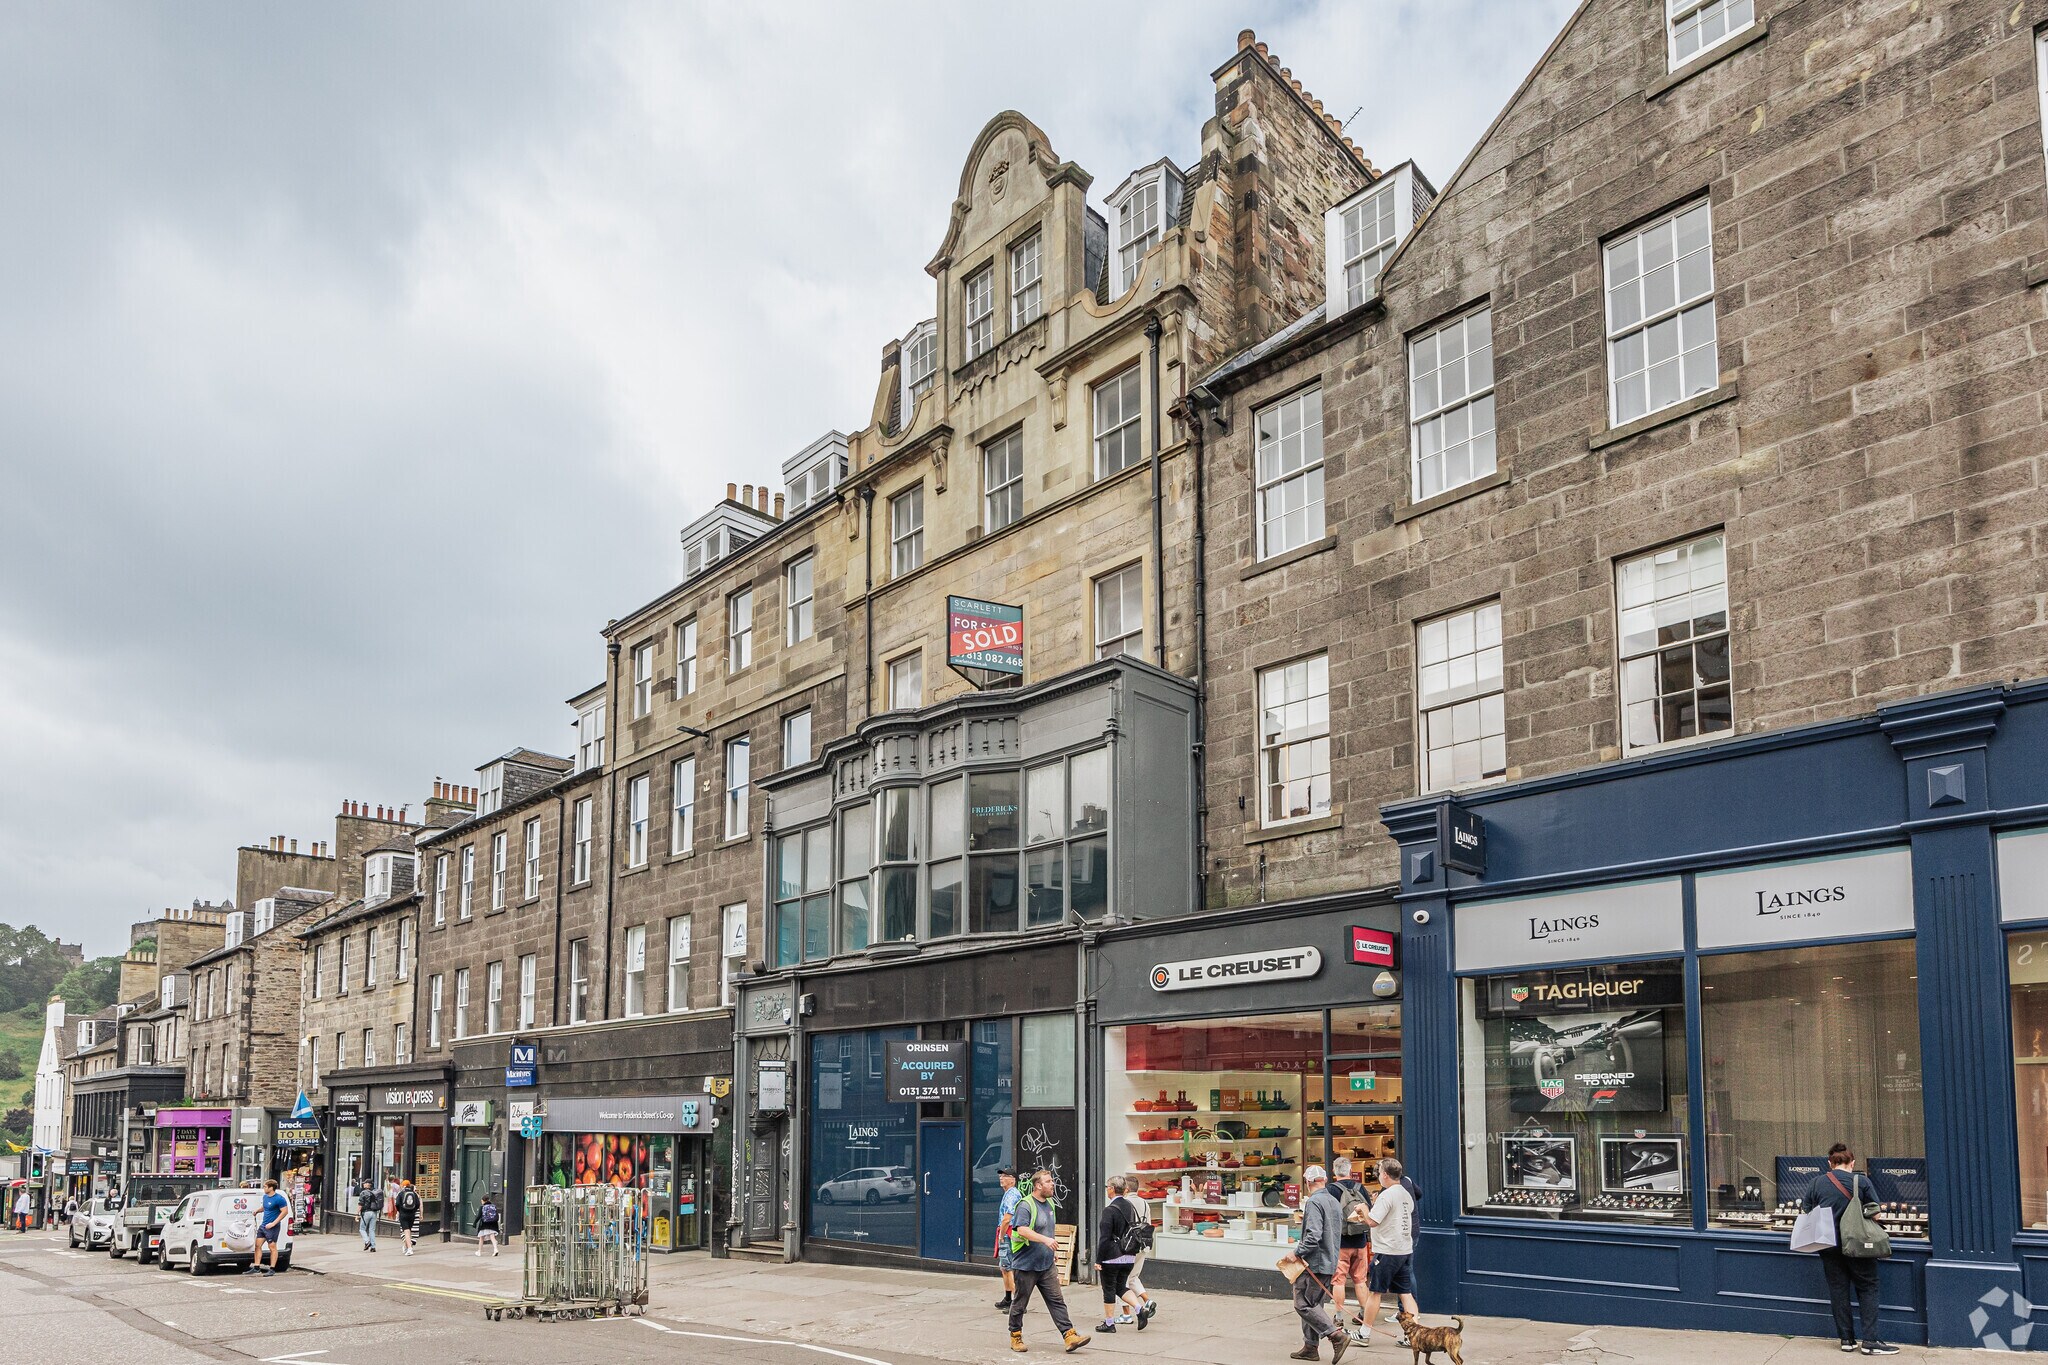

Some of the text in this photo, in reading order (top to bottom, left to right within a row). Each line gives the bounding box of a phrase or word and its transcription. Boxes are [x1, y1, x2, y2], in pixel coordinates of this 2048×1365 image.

[954, 599, 1002, 614] SCARLETT
[954, 617, 978, 630] FOR
[962, 626, 1017, 650] SOLD
[985, 653, 1004, 664] 082
[1006, 656, 1023, 667] 468
[971, 804, 1018, 814] FREDERICKS
[1454, 826, 1478, 846] LAINGS
[1755, 886, 1845, 916] LAINGS
[1529, 915, 1599, 941] LAINGS
[1368, 944, 1388, 952] CREUSET
[1178, 954, 1305, 982] LE CREUSET
[906, 1044, 949, 1052] ORINSEN
[901, 1061, 955, 1070] ACQUIRED
[920, 1072, 935, 1080] BY
[1574, 1072, 1635, 1080] DESIGNED
[1543, 1080, 1562, 1088] TAG
[899, 1086, 956, 1096] 0131 374 1111
[386, 1087, 434, 1108] vision express
[599, 1111, 618, 1120] Welcome
[623, 1111, 642, 1120] Frederick
[278, 1121, 303, 1129] breck
[848, 1124, 879, 1140] LAINGS
